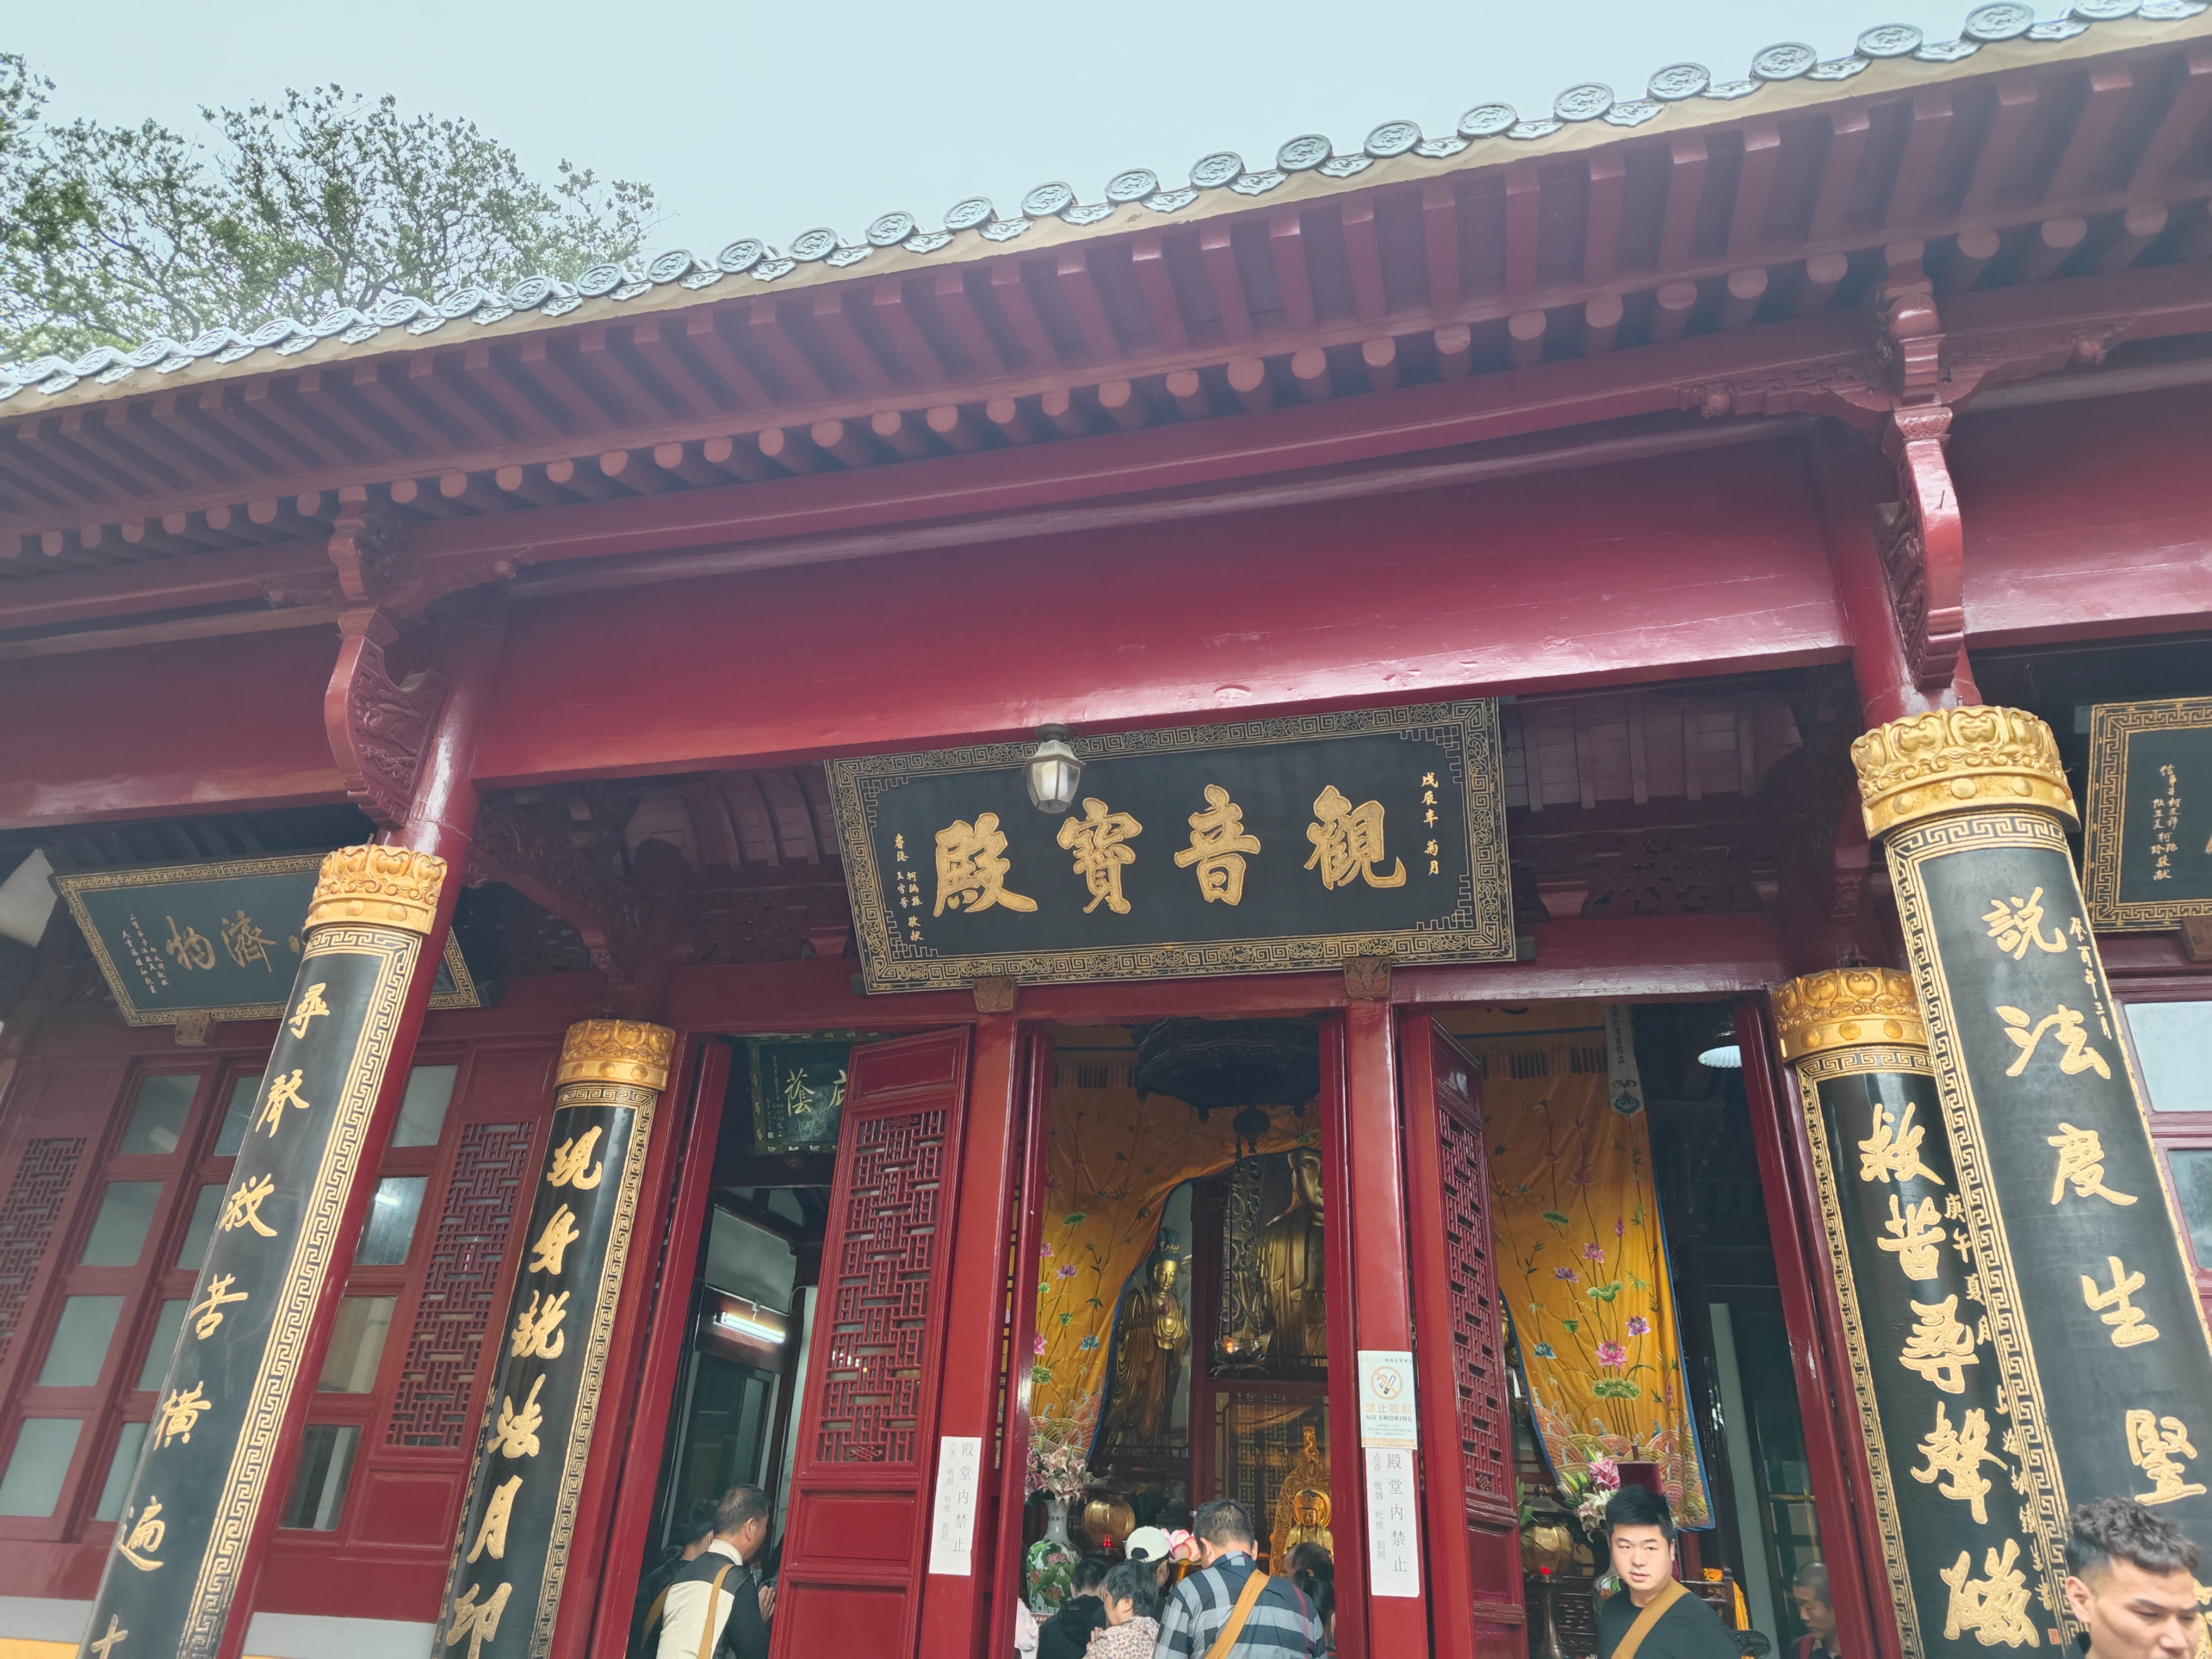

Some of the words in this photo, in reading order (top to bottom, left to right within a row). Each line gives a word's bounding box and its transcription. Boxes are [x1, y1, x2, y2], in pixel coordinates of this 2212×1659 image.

[933, 785, 1406, 918] 觀音寶殿
[166, 910, 300, 973] 濟物
[1365, 1403, 1412, 1415] 禁止吸烟
[952, 1442, 974, 1553] 殿堂内禁止
[1387, 1453, 1407, 1572] 殿堂内禁止
